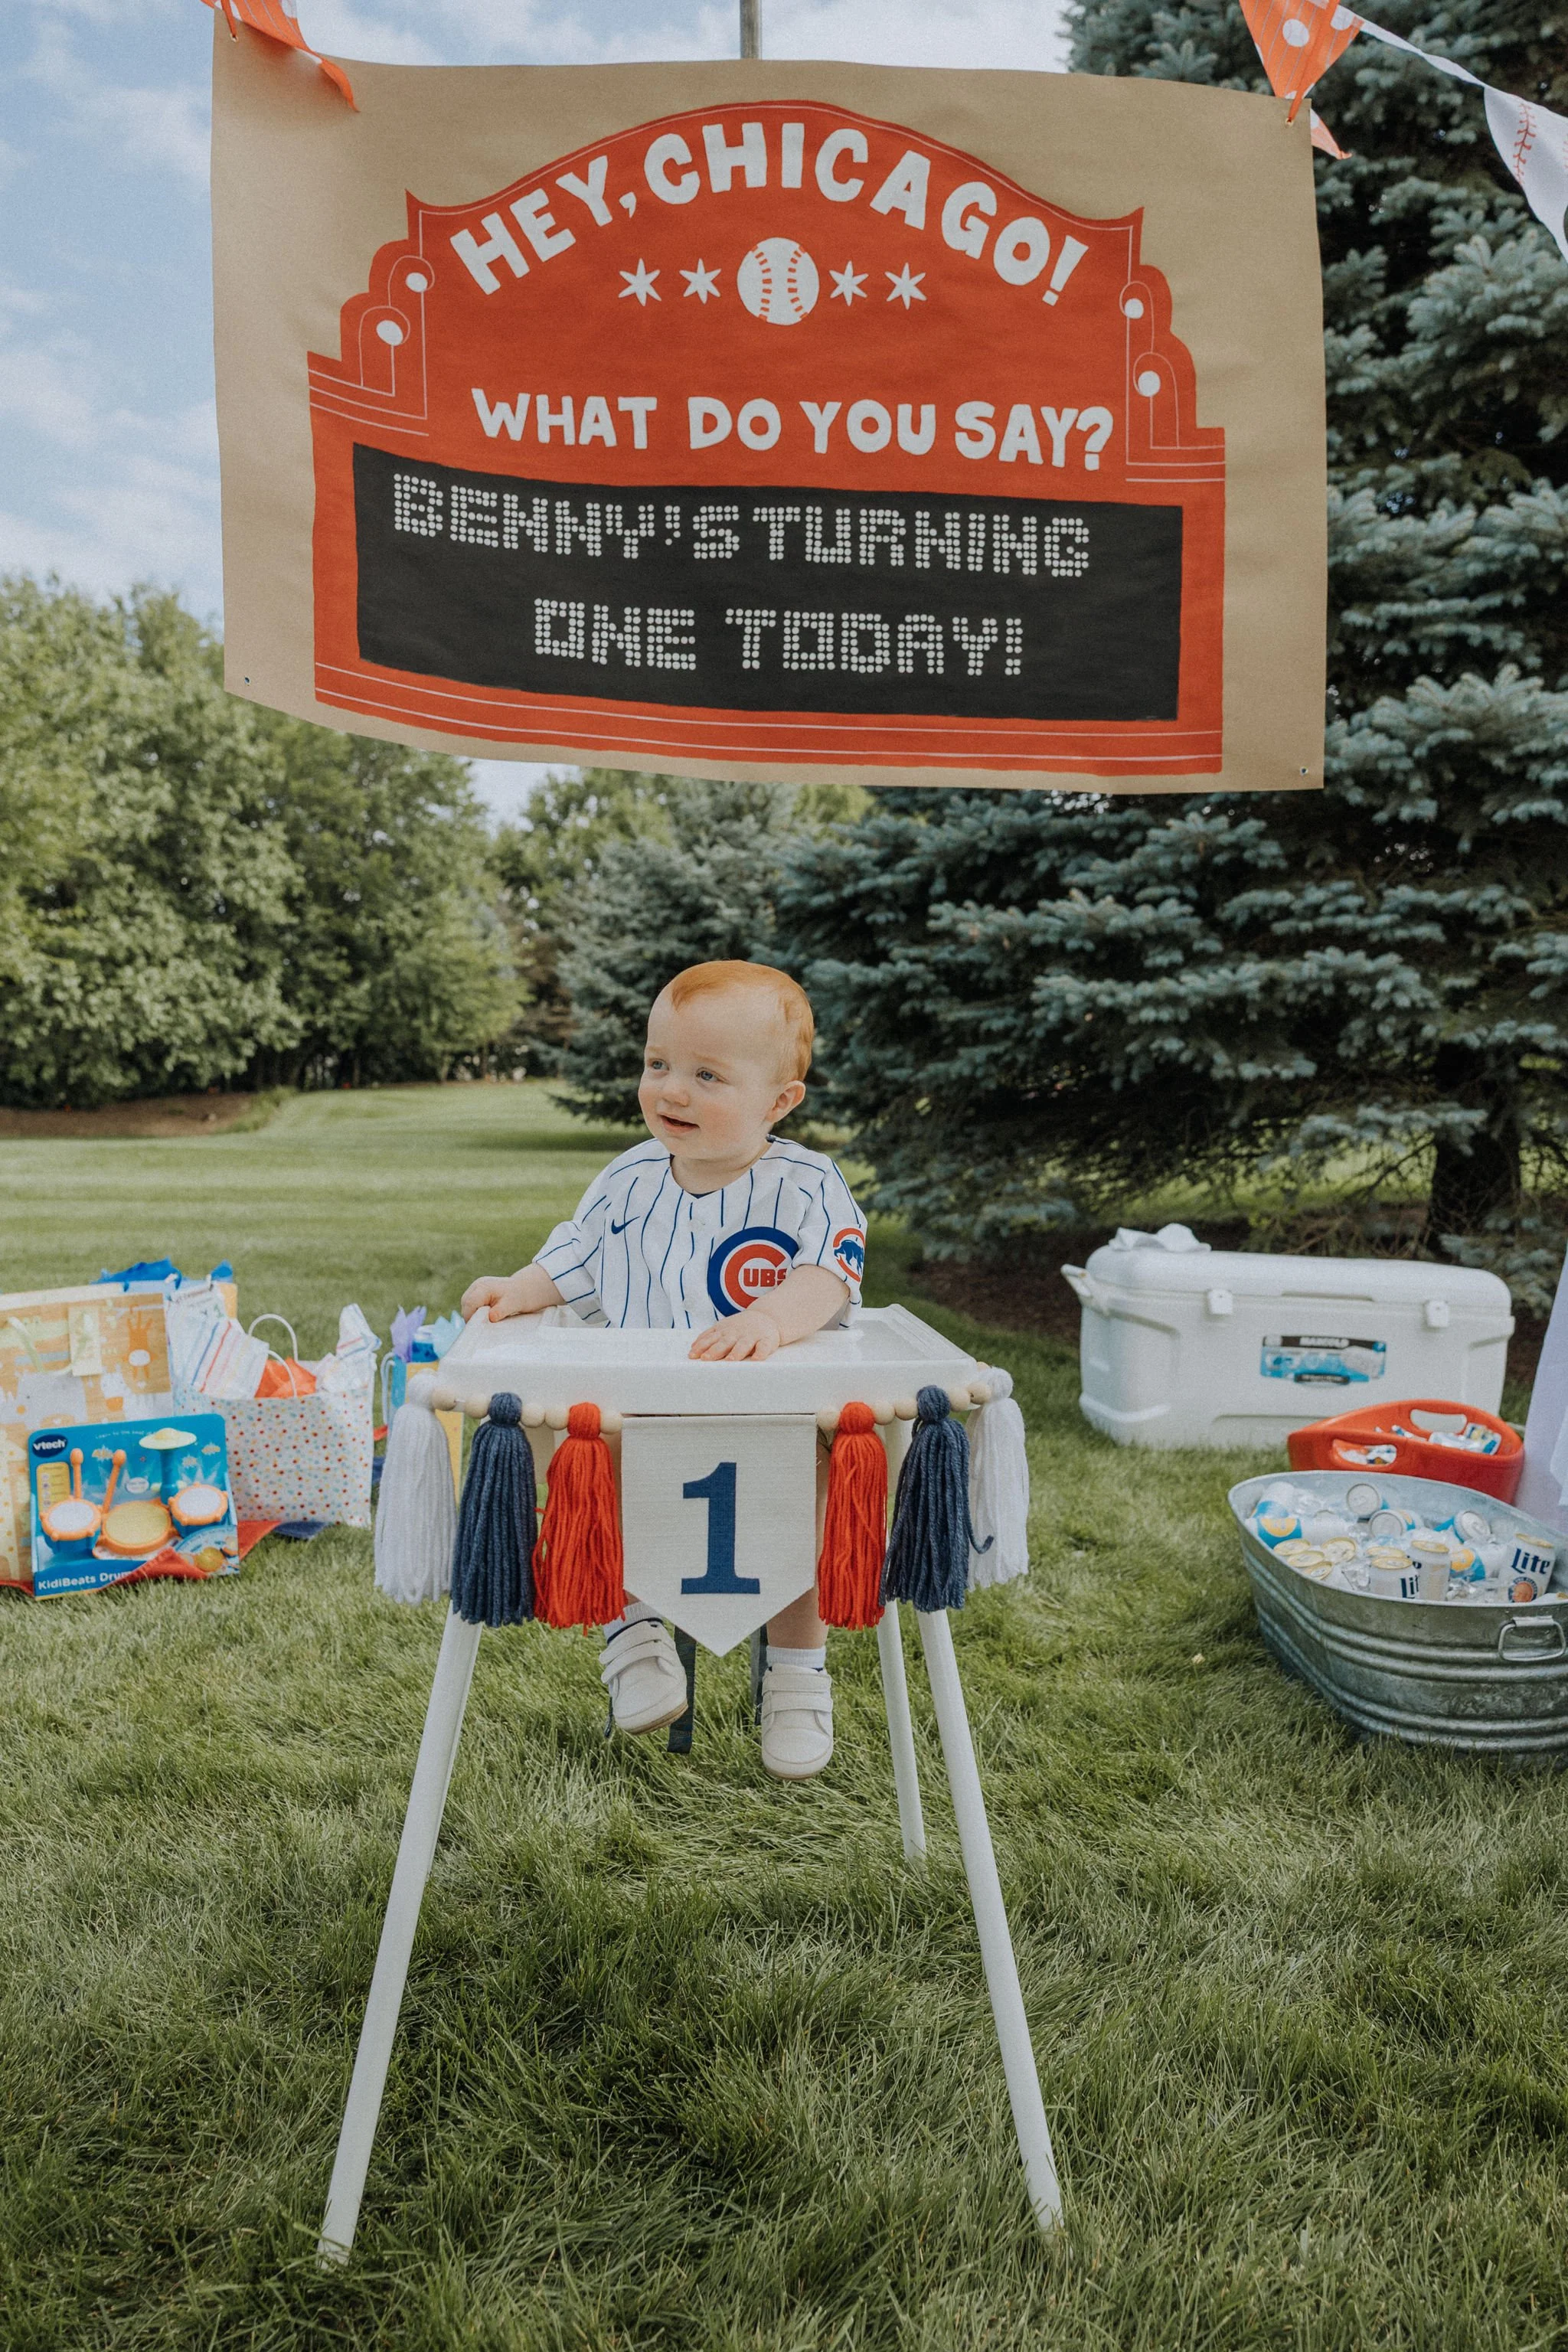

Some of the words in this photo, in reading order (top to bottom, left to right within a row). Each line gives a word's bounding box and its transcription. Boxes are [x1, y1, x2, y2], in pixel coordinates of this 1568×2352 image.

[450, 155, 637, 295] HEY,
[645, 122, 1089, 305] CHICAGO!
[471, 387, 658, 449] WHAT
[688, 396, 782, 451] DO
[799, 400, 936, 456] YOU
[955, 400, 1114, 471] SAY?
[394, 473, 740, 560] BENNY'S
[752, 505, 1089, 577] TURNING
[534, 597, 697, 671] ONE
[725, 608, 1024, 676] TODAY!
[681, 1462, 760, 1595] 1
[1511, 1547, 1550, 1575] Lite
[38, 1575, 96, 1590] KidiBeats
